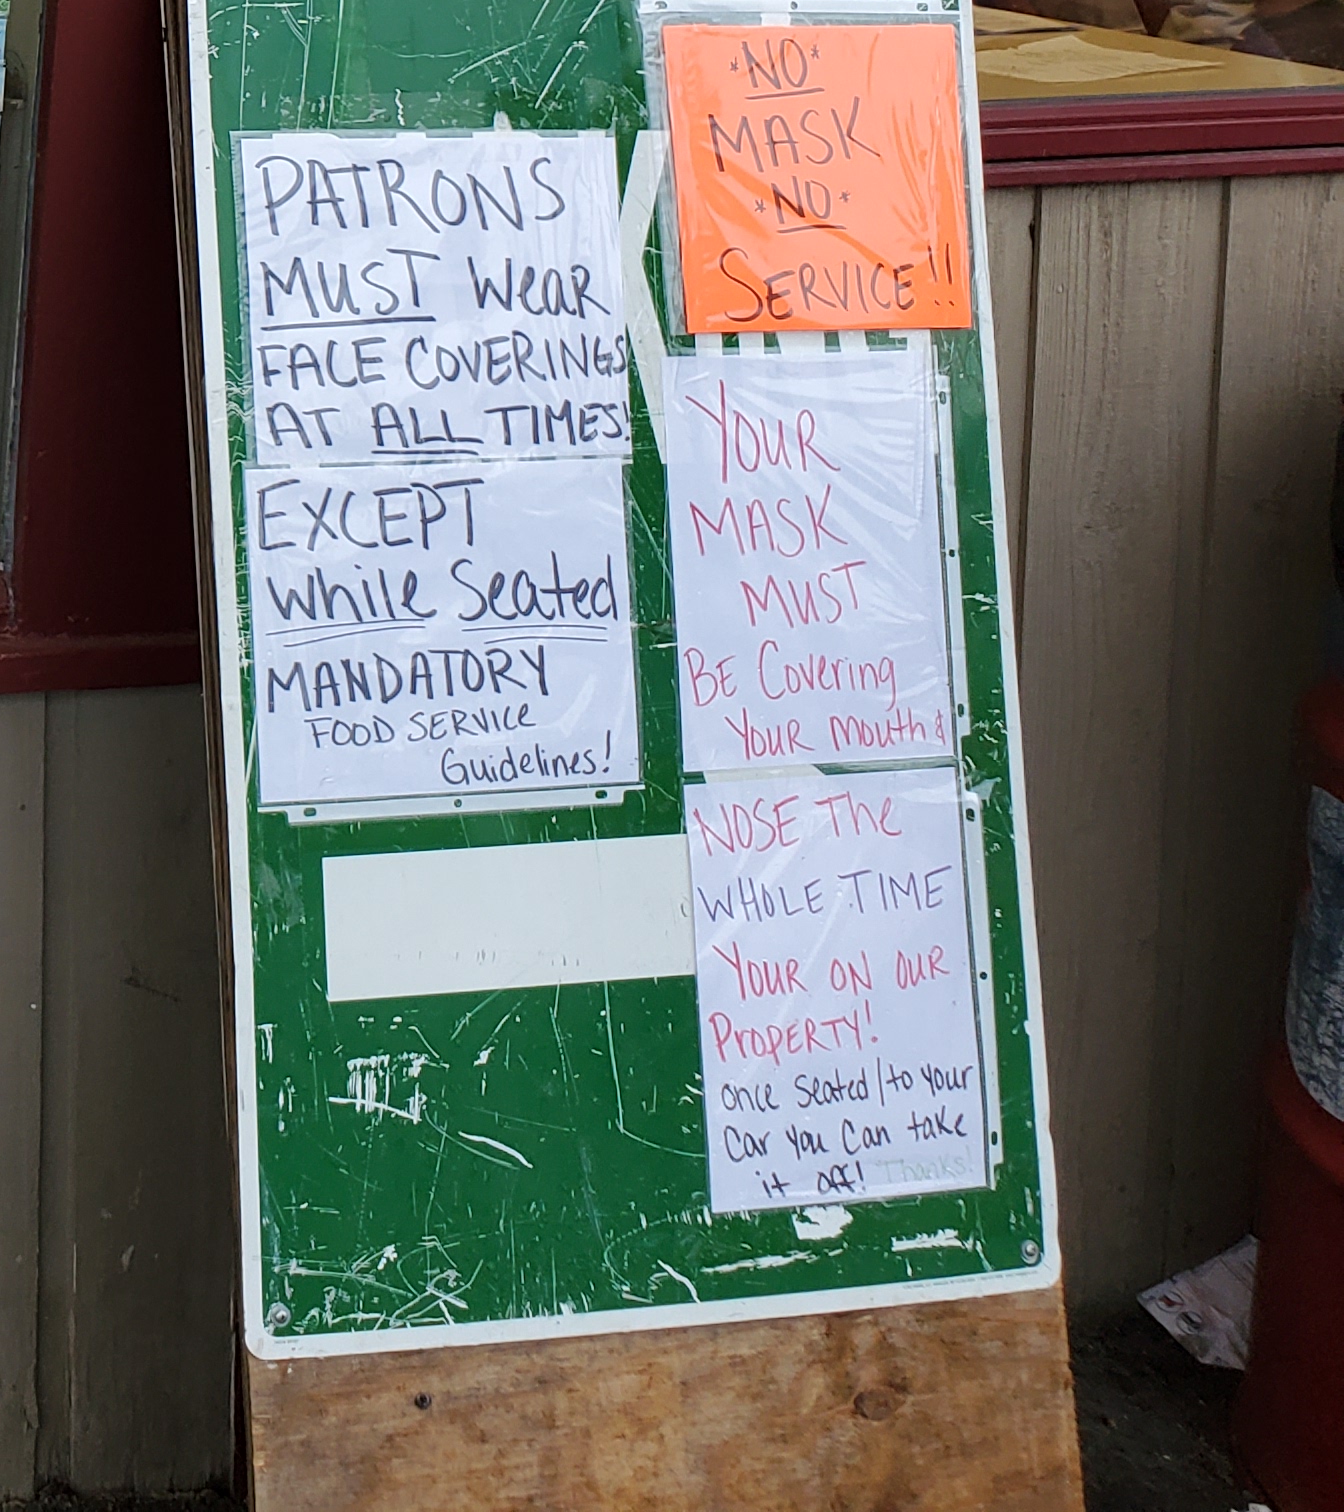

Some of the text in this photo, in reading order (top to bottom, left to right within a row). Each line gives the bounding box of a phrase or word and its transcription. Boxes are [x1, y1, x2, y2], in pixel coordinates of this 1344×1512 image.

[708, 96, 880, 174] MASK
[255, 156, 565, 236] PATRONS
[260, 248, 441, 321] MUST
[258, 333, 626, 391] FACE COVERINGS
[265, 403, 631, 449] AT ALL TIMES!
[258, 477, 484, 551] EXCEPT
[740, 561, 866, 629] MUST
[267, 645, 549, 713] MANDATORY
[309, 717, 394, 748] FOOD
[441, 732, 611, 786] Guidelines!
[698, 865, 952, 923] WHOLE TIME
[756, 1171, 791, 1199] it
[879, 1146, 974, 1182] Thanks!
